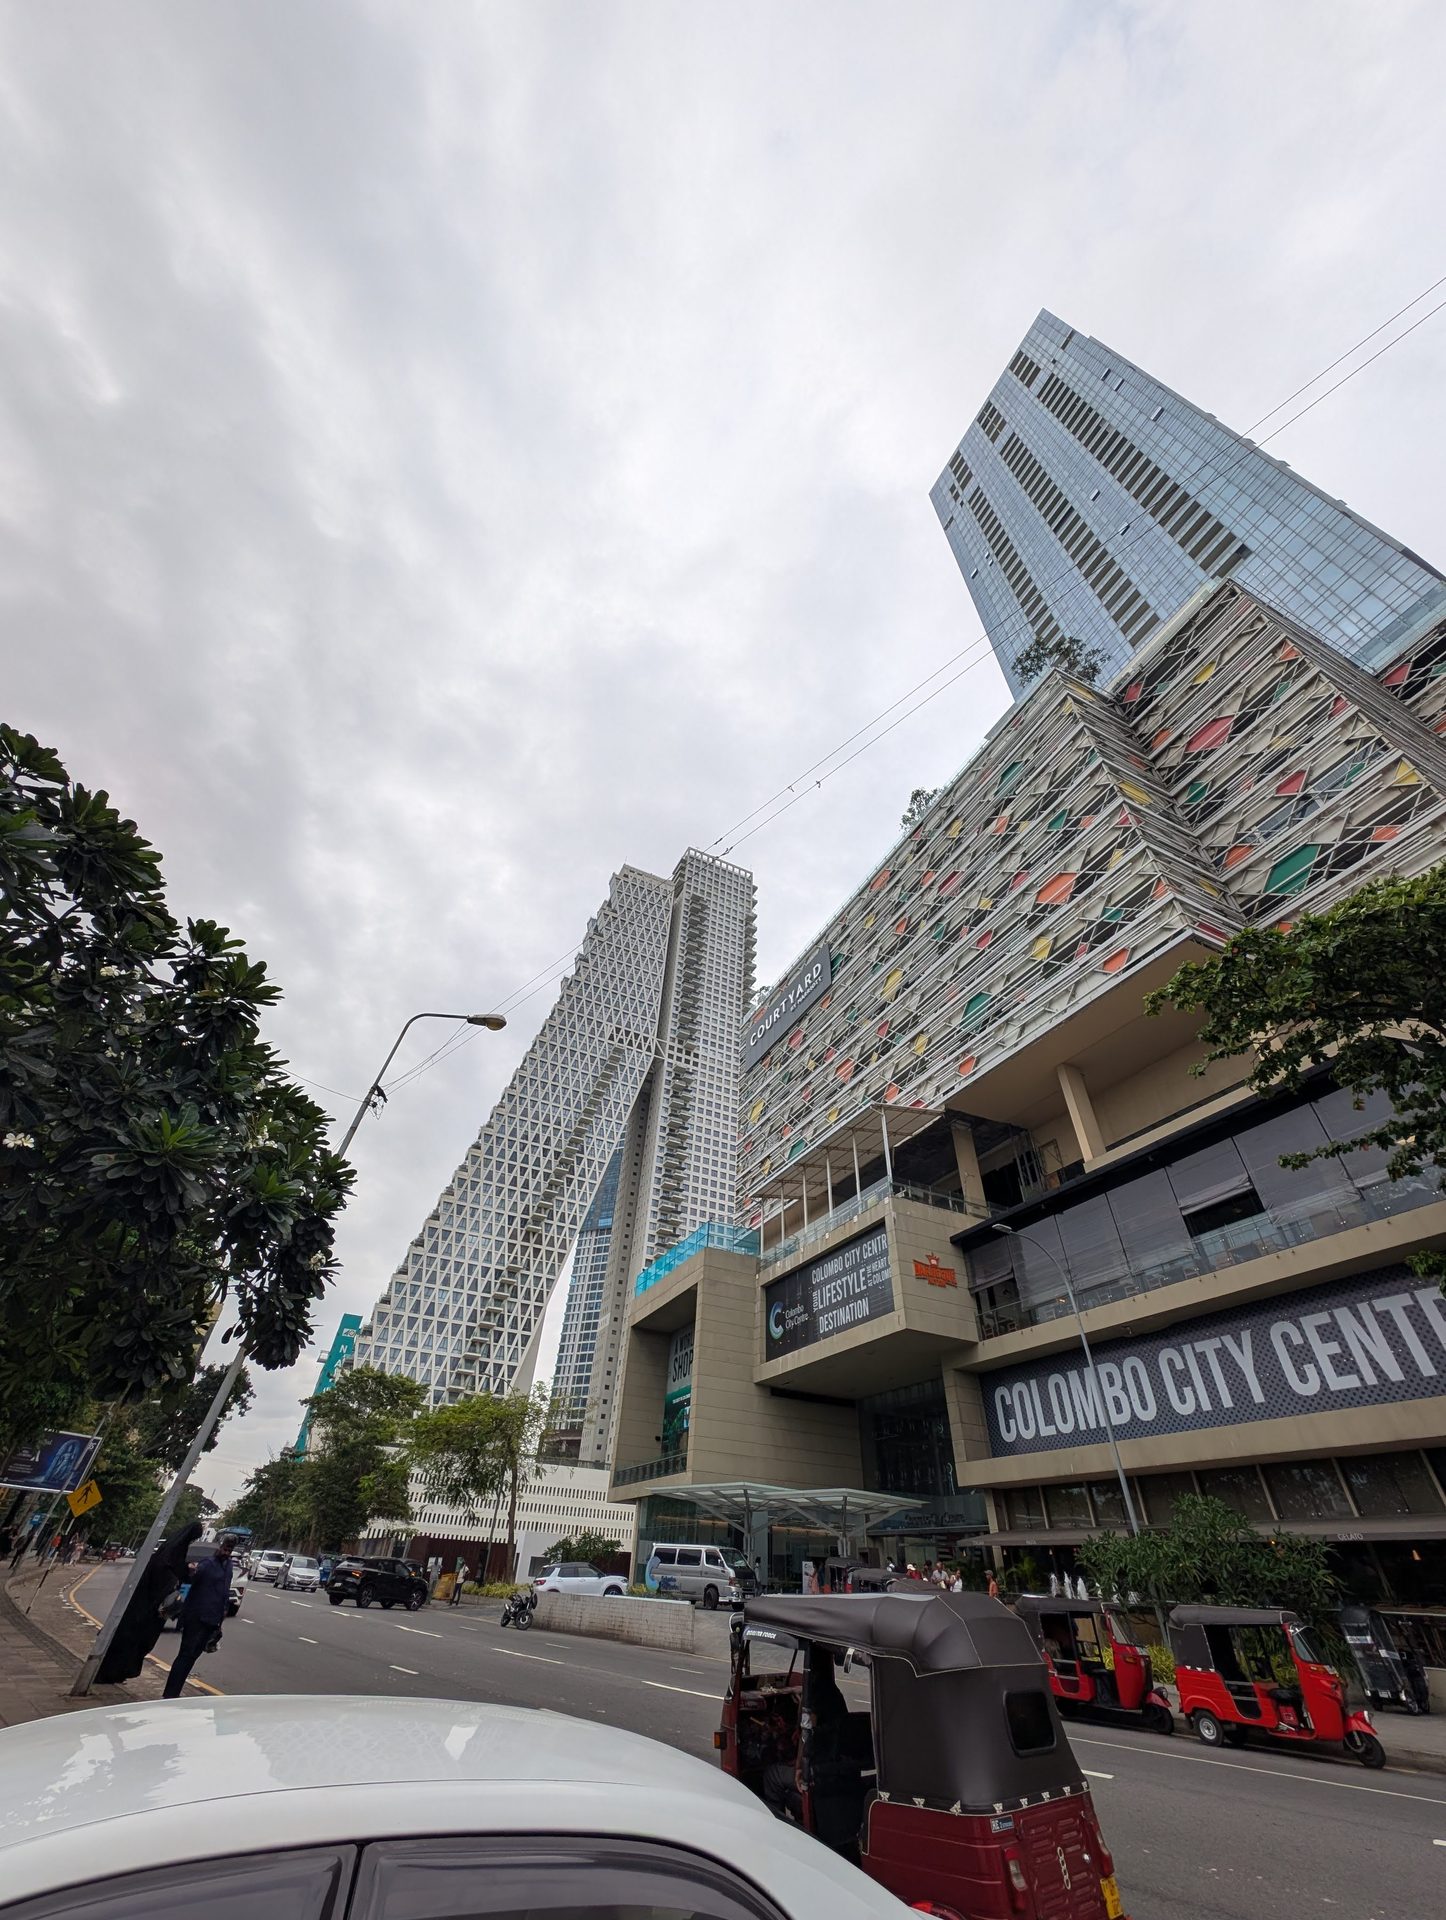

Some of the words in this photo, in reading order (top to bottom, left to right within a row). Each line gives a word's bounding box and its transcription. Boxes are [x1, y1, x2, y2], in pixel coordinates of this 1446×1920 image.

[750, 963, 822, 1046] COURTYARD
[811, 1256, 843, 1285] COLOMBO
[844, 1247, 861, 1268] CITY
[817, 1268, 867, 1309] LIFESTYLE
[819, 1297, 870, 1333] DESTINATION
[995, 1356, 1158, 1442] COLOMBO
[1158, 1330, 1265, 1415] CITY
